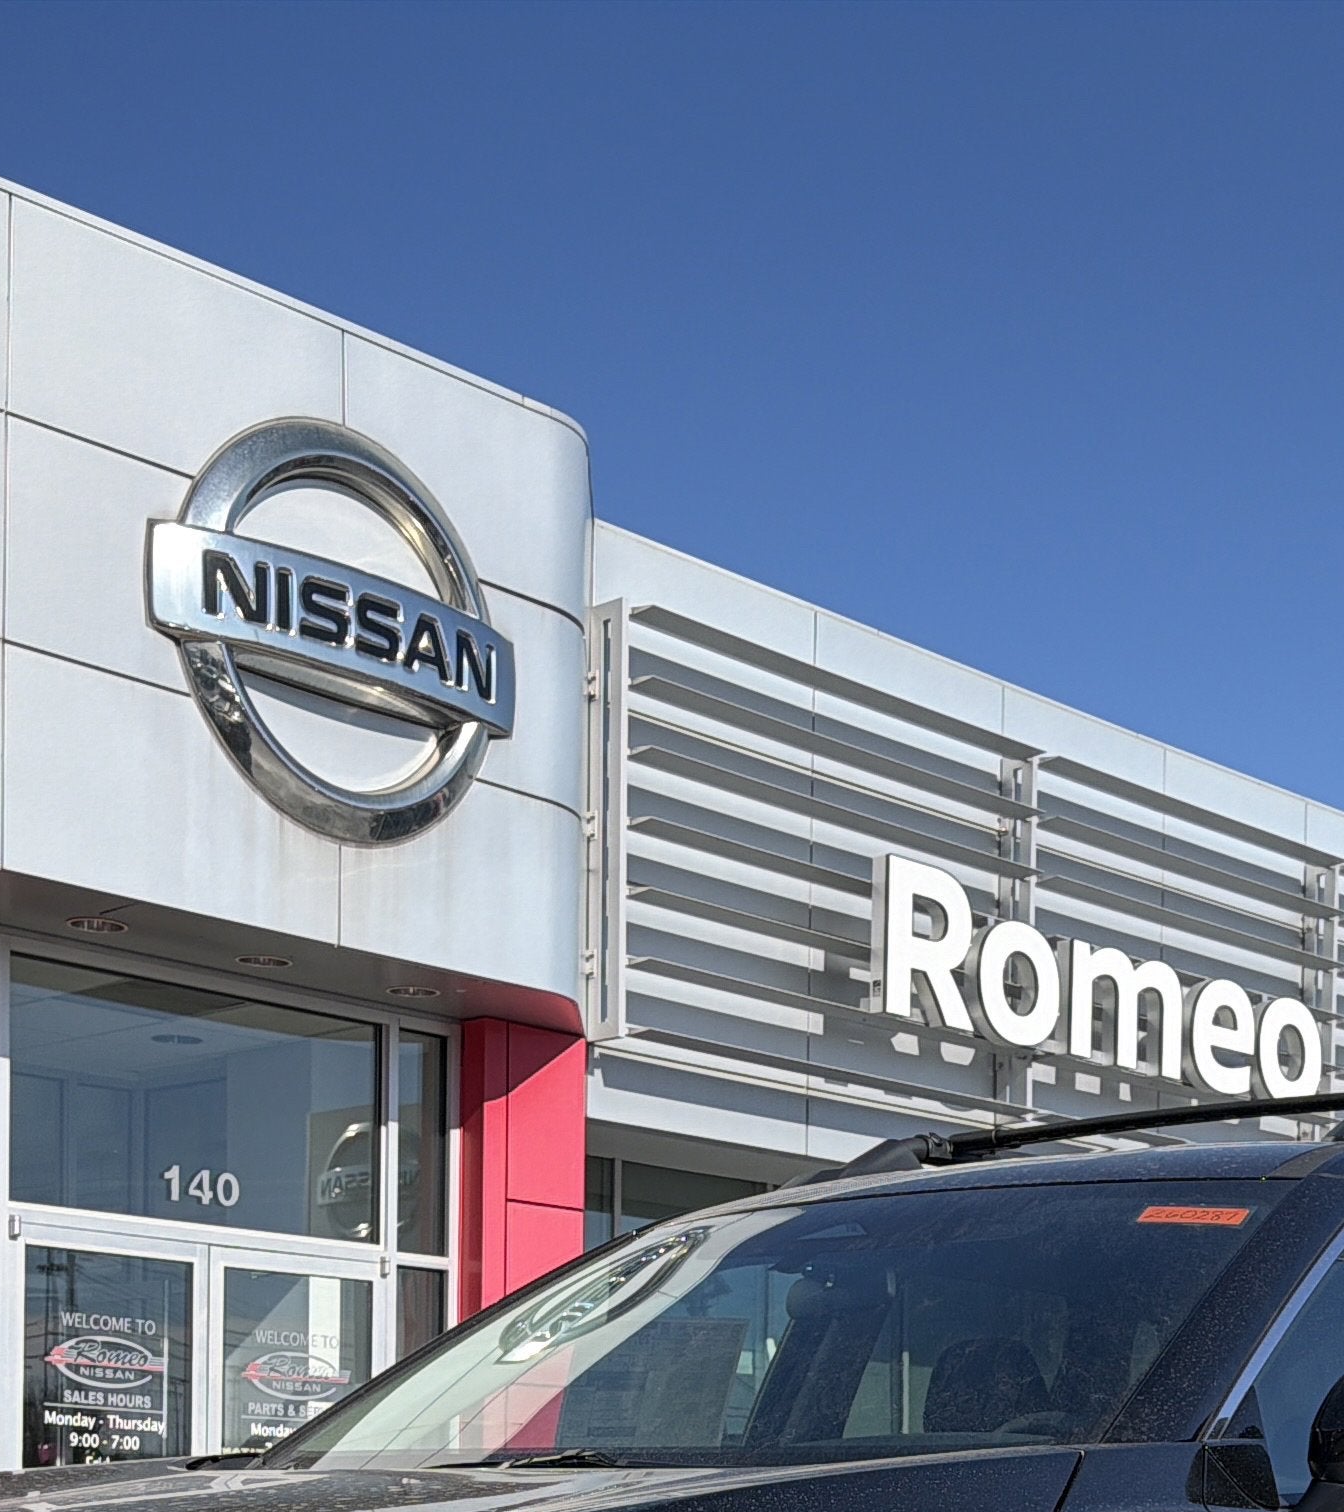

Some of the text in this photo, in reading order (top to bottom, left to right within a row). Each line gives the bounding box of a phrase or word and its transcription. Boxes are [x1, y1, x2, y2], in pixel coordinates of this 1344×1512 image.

[201, 549, 496, 704] NISSAN
[873, 853, 1322, 1099] Romeo
[163, 1165, 241, 1207] 140
[60, 1311, 156, 1336] WELCOME TO
[256, 1329, 340, 1349] WELCOME TO
[68, 1339, 149, 1366] Romeo
[79, 1366, 135, 1379] NISSAN
[272, 1381, 321, 1393] NISSAN
[63, 1389, 152, 1409] SALES HOURS
[248, 1402, 284, 1417] PARTS
[287, 1404, 296, 1417] &
[44, 1410, 96, 1430] Monday
[106, 1414, 166, 1436] Thursday
[69, 1432, 100, 1448] 9:00
[110, 1434, 140, 1450] 7:00
